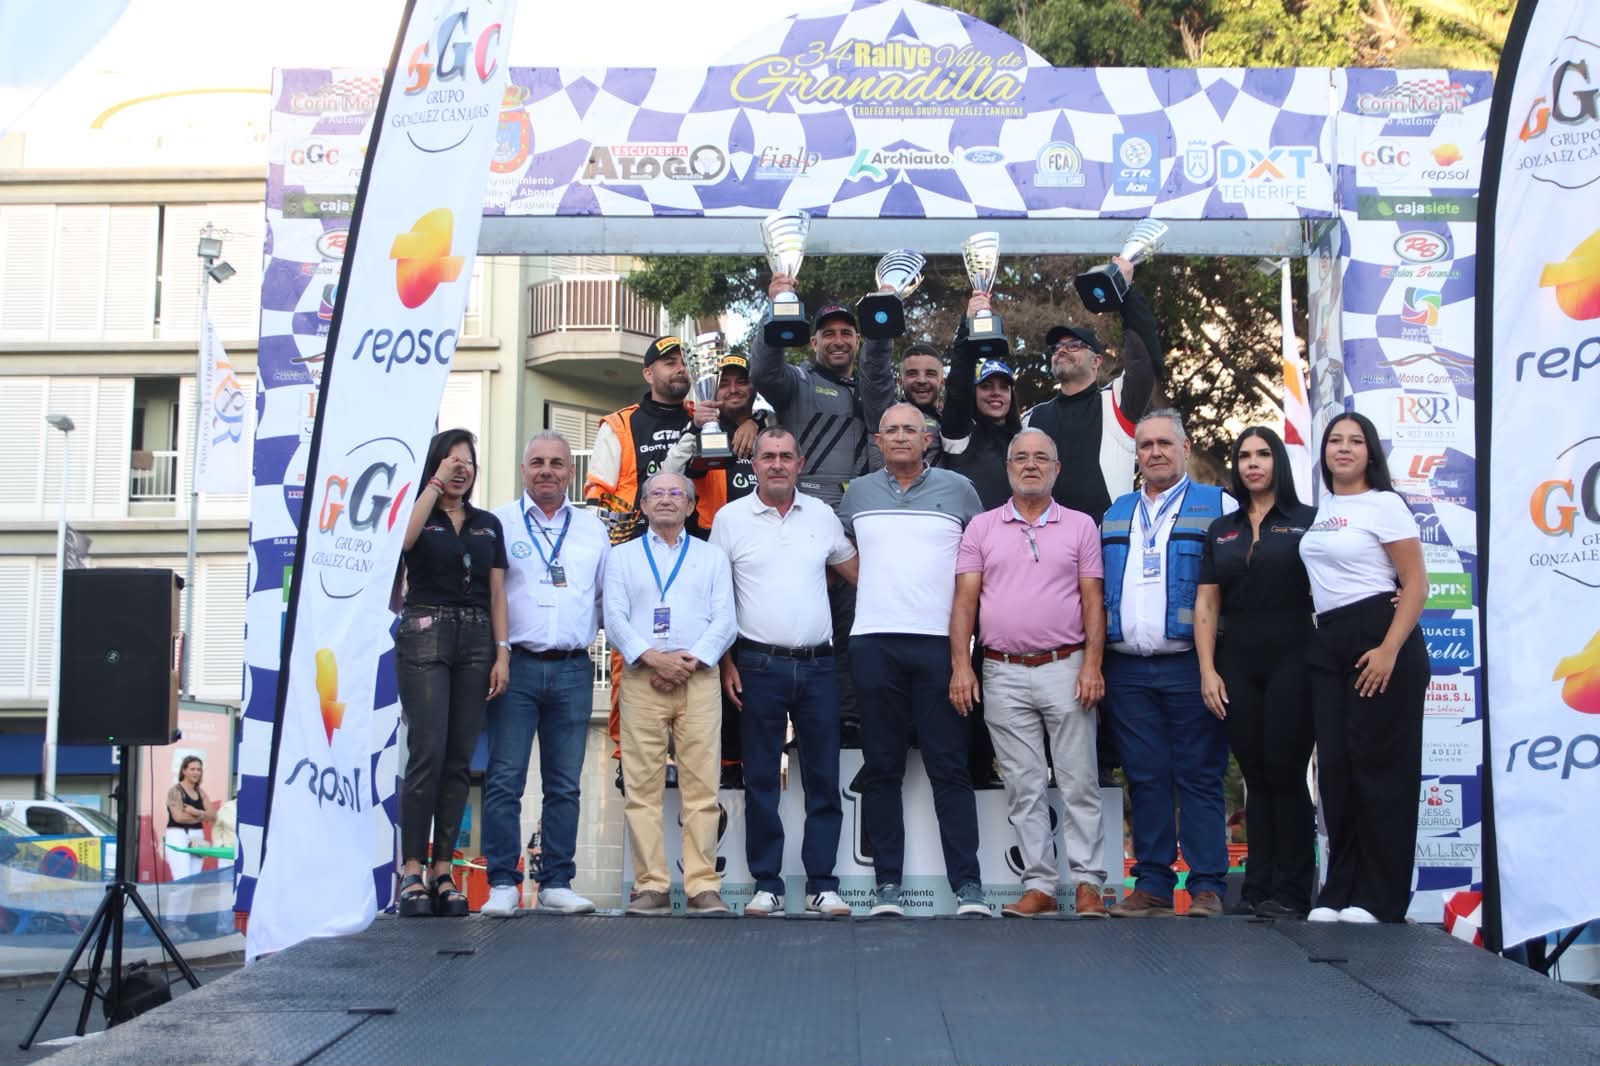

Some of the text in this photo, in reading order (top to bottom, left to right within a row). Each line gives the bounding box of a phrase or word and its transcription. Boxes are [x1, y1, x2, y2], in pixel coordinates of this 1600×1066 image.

[855, 41, 931, 71] Rallye
[935, 45, 994, 68] Villa
[997, 47, 1025, 68] de
[730, 55, 1026, 110] Granadilla
[426, 89, 465, 106] GRUPO
[1358, 95, 1463, 114] Corin Metal
[290, 144, 340, 165] GGC
[871, 151, 950, 165] Archiauto
[970, 151, 997, 164] Ford
[1048, 154, 1070, 170] FCA
[1361, 146, 1411, 168] GGC
[1220, 148, 1313, 179] DXT
[1120, 169, 1152, 178] CTR
[1421, 168, 1470, 182] repsol
[1222, 184, 1307, 200] TENERIFE
[1395, 201, 1461, 217] cajasiete
[1397, 395, 1454, 424] R&R
[1408, 455, 1448, 478] LF
[1428, 582, 1468, 599] prix
[903, 898, 934, 908] Abona
